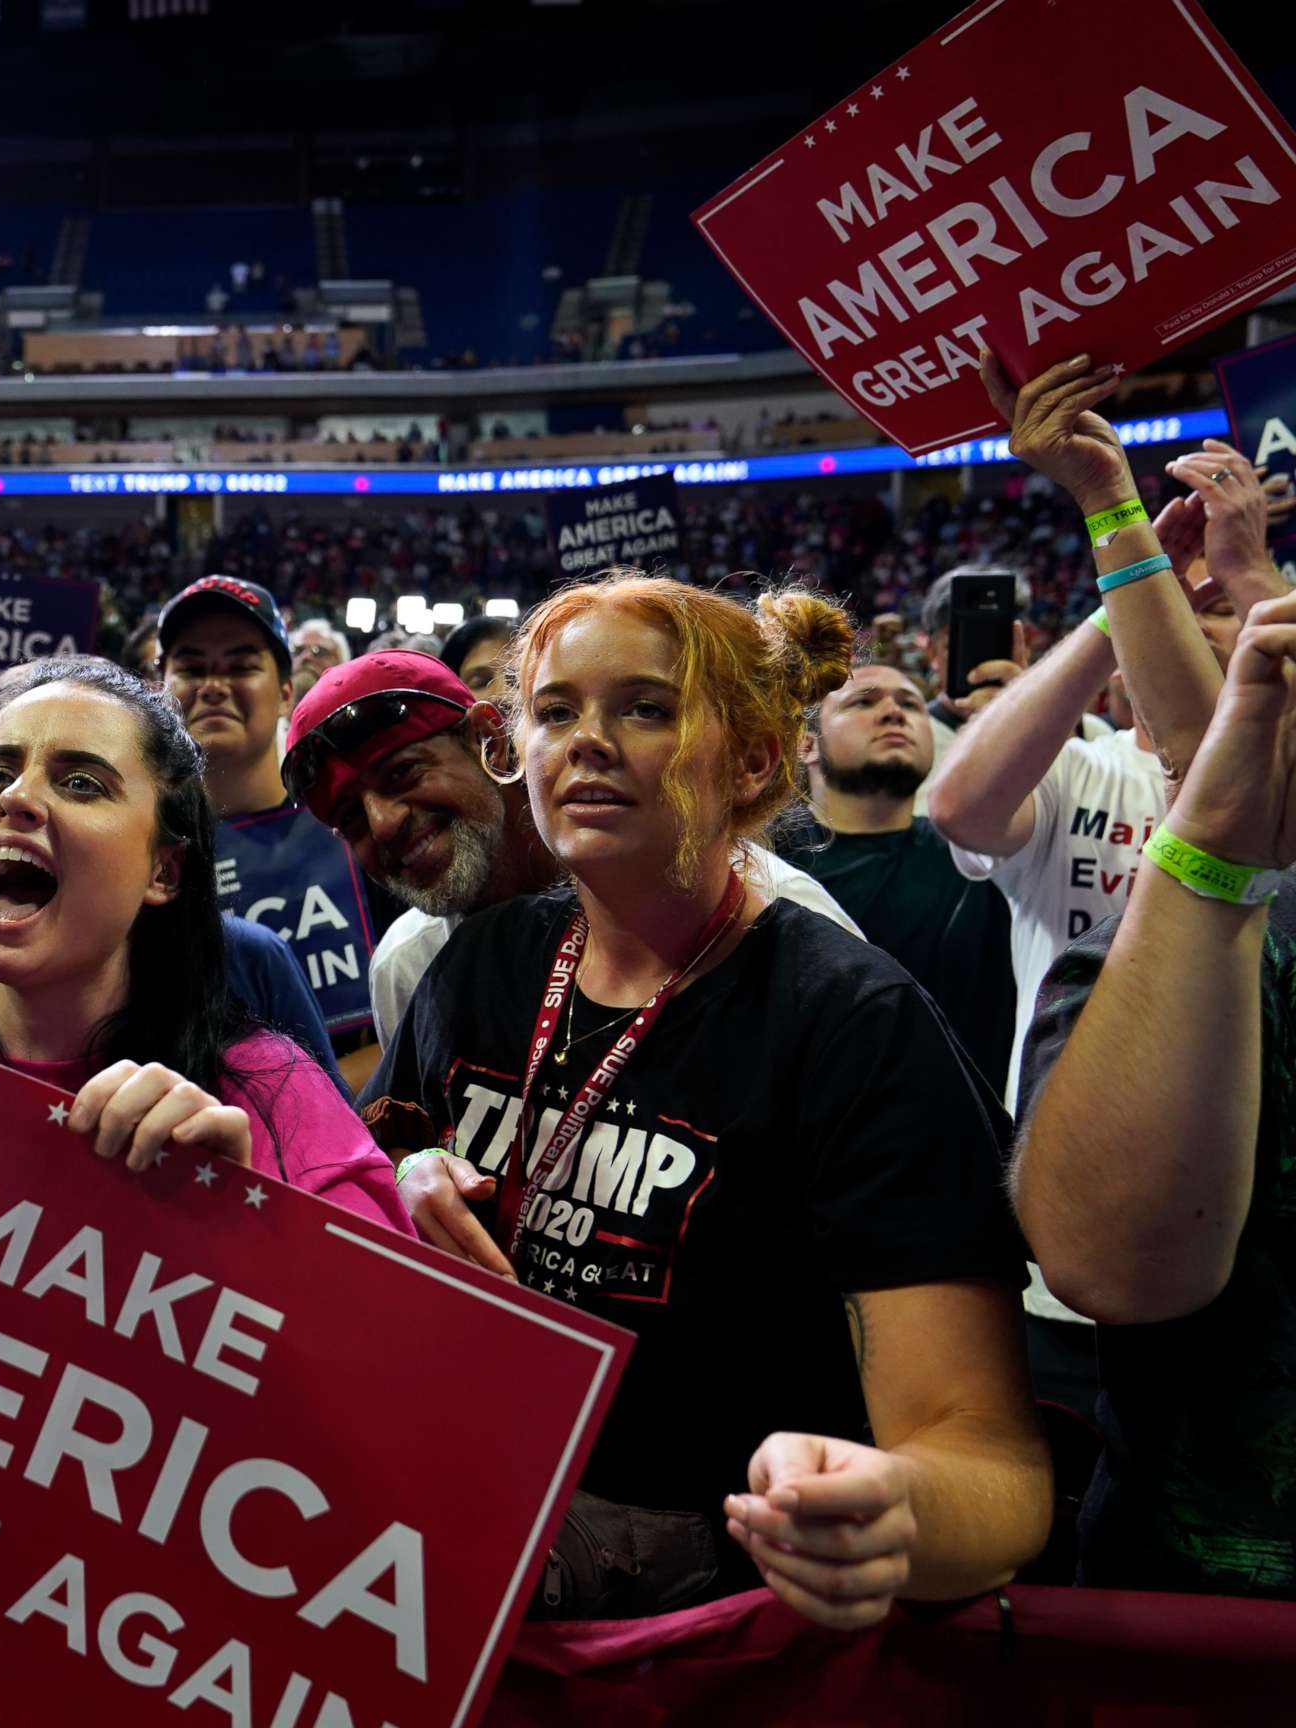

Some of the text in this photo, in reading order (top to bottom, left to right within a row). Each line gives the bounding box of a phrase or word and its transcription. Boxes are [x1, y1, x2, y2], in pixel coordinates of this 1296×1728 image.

[816, 97, 1003, 244] MAKE
[798, 86, 1229, 360] AMERICA
[852, 155, 1282, 407] GREAT AGAIN
[498, 466, 593, 489] AMERICA
[584, 490, 638, 518] MAKE
[558, 505, 676, 551] AMERICA
[560, 531, 680, 572] GREAT AGAIN
[543, 958, 577, 1009] SIUE
[454, 1082, 697, 1218] TRUMP
[510, 1033, 638, 1255] SIUE Political Science
[524, 1193, 596, 1248] 020
